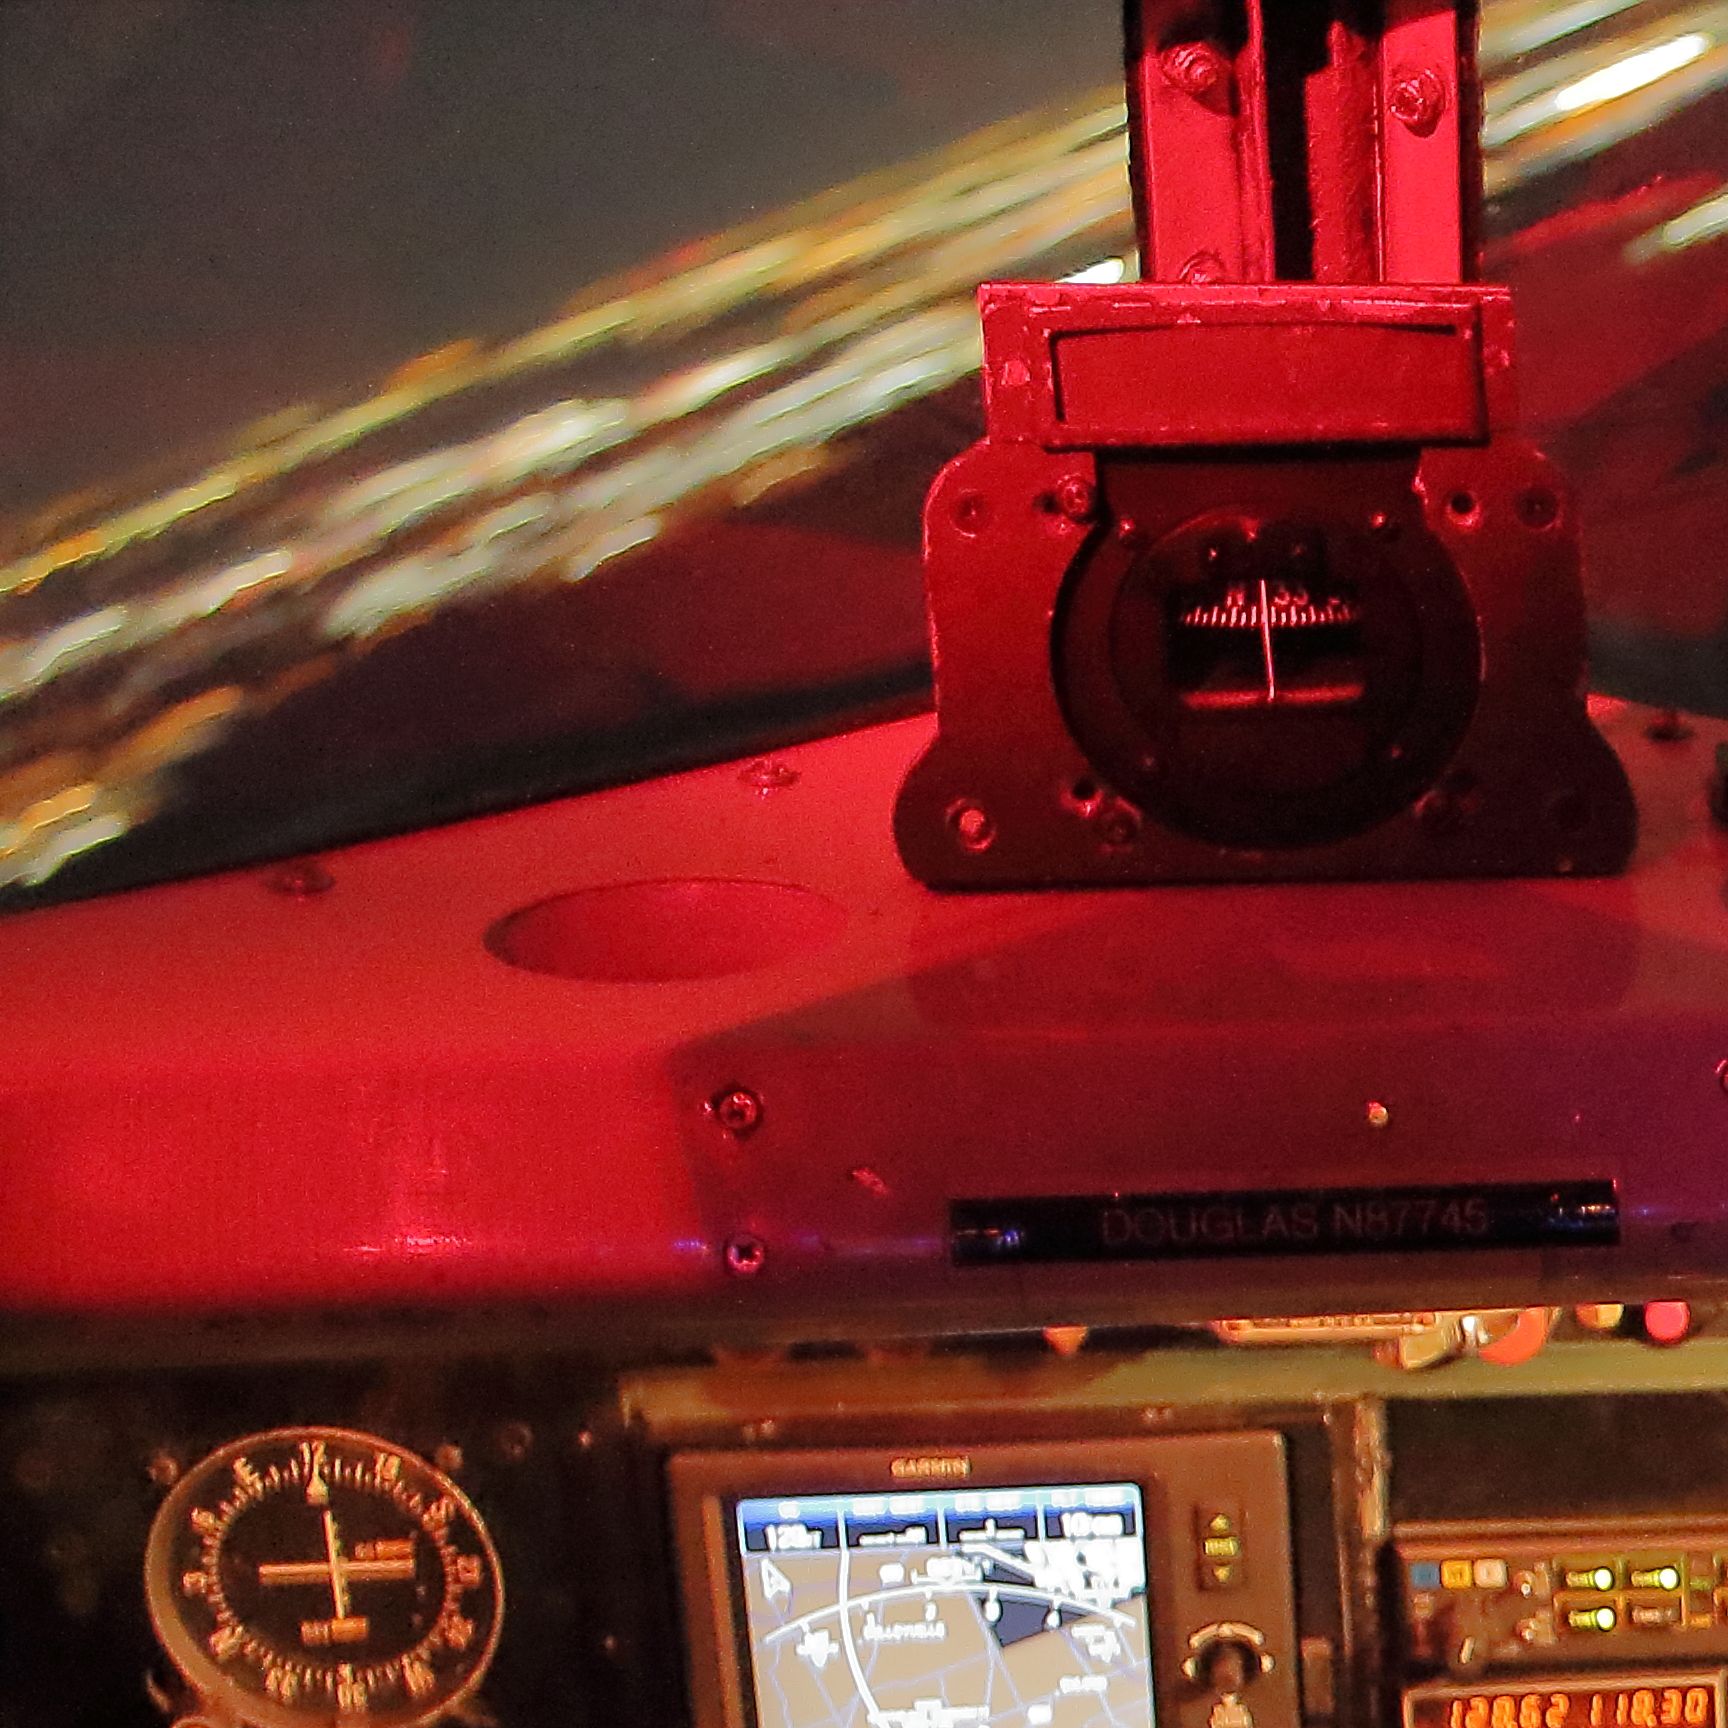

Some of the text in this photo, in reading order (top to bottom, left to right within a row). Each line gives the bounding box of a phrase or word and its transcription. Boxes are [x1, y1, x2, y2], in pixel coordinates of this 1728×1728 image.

[1103, 1196, 1490, 1247] DOUGLAS N87745
[890, 1457, 971, 1478] GARMIN
